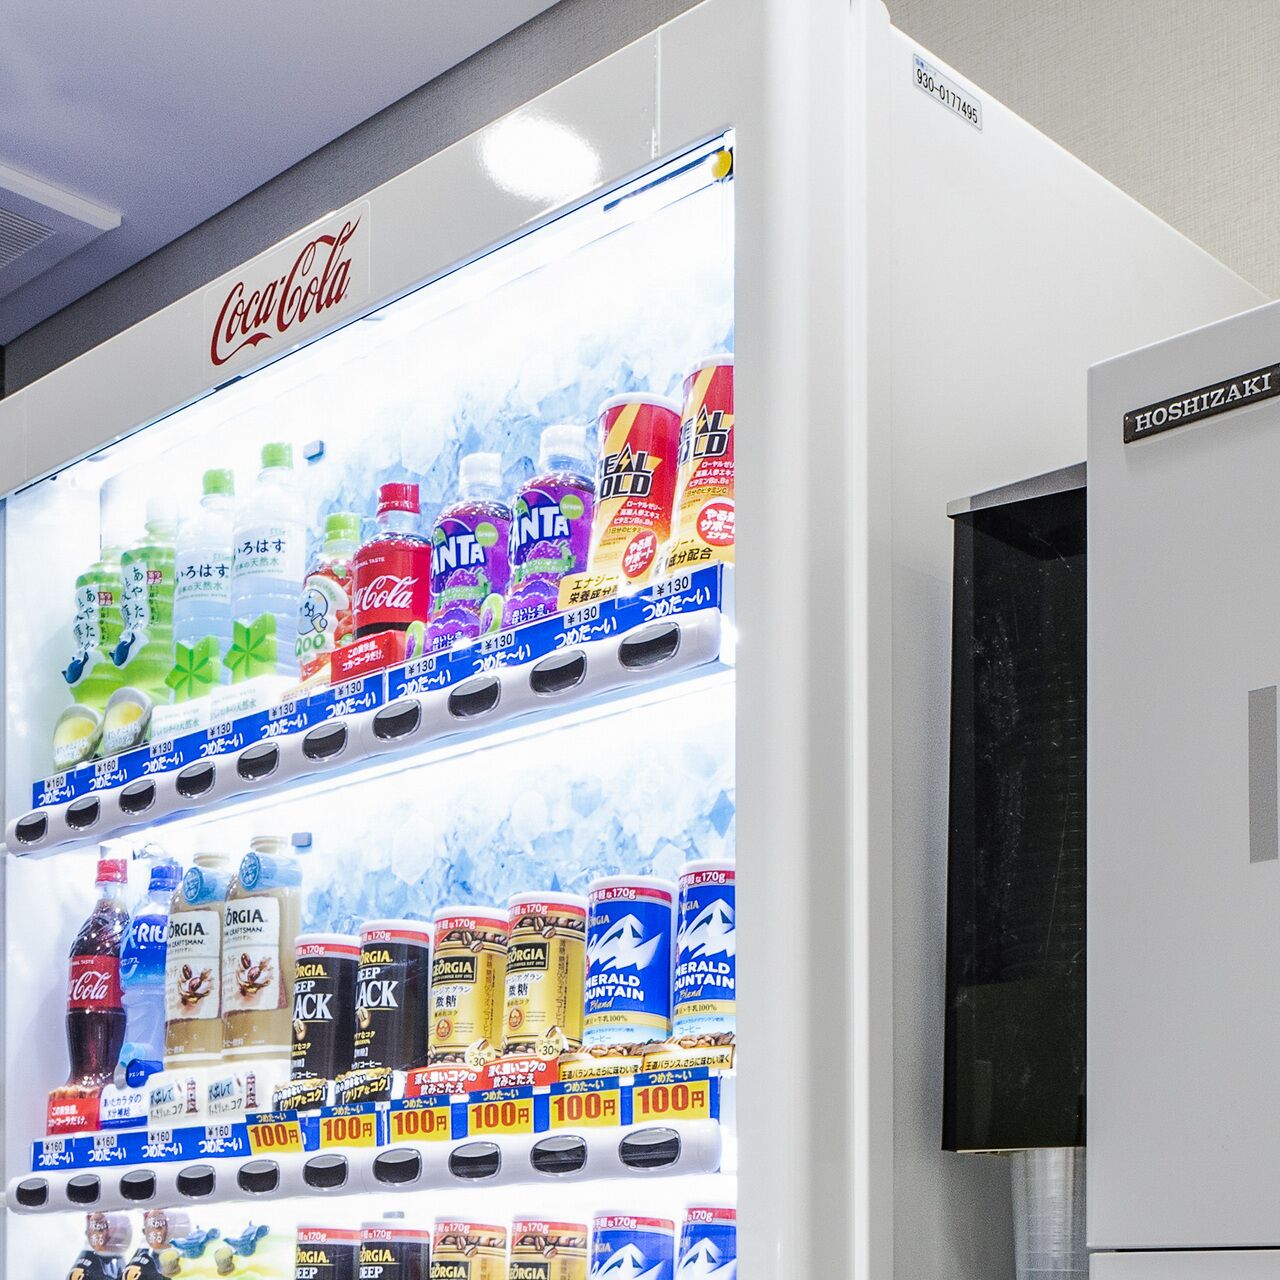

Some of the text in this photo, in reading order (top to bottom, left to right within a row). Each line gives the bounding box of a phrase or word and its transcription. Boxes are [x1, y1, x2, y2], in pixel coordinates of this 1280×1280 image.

[917, 69, 977, 123] 930-0177495
[210, 214, 363, 366] Coca-Cola
[1134, 373, 1272, 433] HOSHIZAKI
[656, 576, 689, 597] ¥130
[566, 607, 598, 625] ¥130
[641, 589, 711, 622] つめた〜い
[553, 616, 618, 648] つめた〜い
[484, 634, 513, 652] ¥130
[407, 659, 434, 676] ¥130
[472, 644, 531, 675] つめた〜い
[337, 681, 362, 697] ¥130
[396, 669, 452, 697] つめた〜い
[271, 702, 295, 718] ¥130
[326, 692, 377, 718] つめた〜い
[209, 722, 232, 738] ¥130
[260, 713, 308, 738] つめた〜い
[152, 742, 172, 756] ¥130
[200, 734, 244, 757] つめた〜い
[96, 760, 116, 773] ¥160
[142, 751, 184, 775] つめた〜い
[46, 777, 65, 791] ¥160
[89, 770, 128, 791] つめた〜い
[38, 786, 75, 806] つめた〜い
[553, 1092, 616, 1119] 100円
[637, 1085, 705, 1113] 100円
[393, 1111, 447, 1135] 100円
[471, 1102, 529, 1127] 100円
[149, 1130, 170, 1143] ¥160
[207, 1125, 229, 1138] ¥160
[250, 1123, 299, 1147] 100円
[322, 1118, 373, 1142] 100円
[44, 1141, 63, 1152] ¥160
[96, 1136, 115, 1147] ¥160
[141, 1141, 183, 1158] つめた〜い
[198, 1136, 242, 1153] つめた〜い
[38, 1151, 74, 1166] つめた〜い
[87, 1146, 127, 1163] つめた〜い
